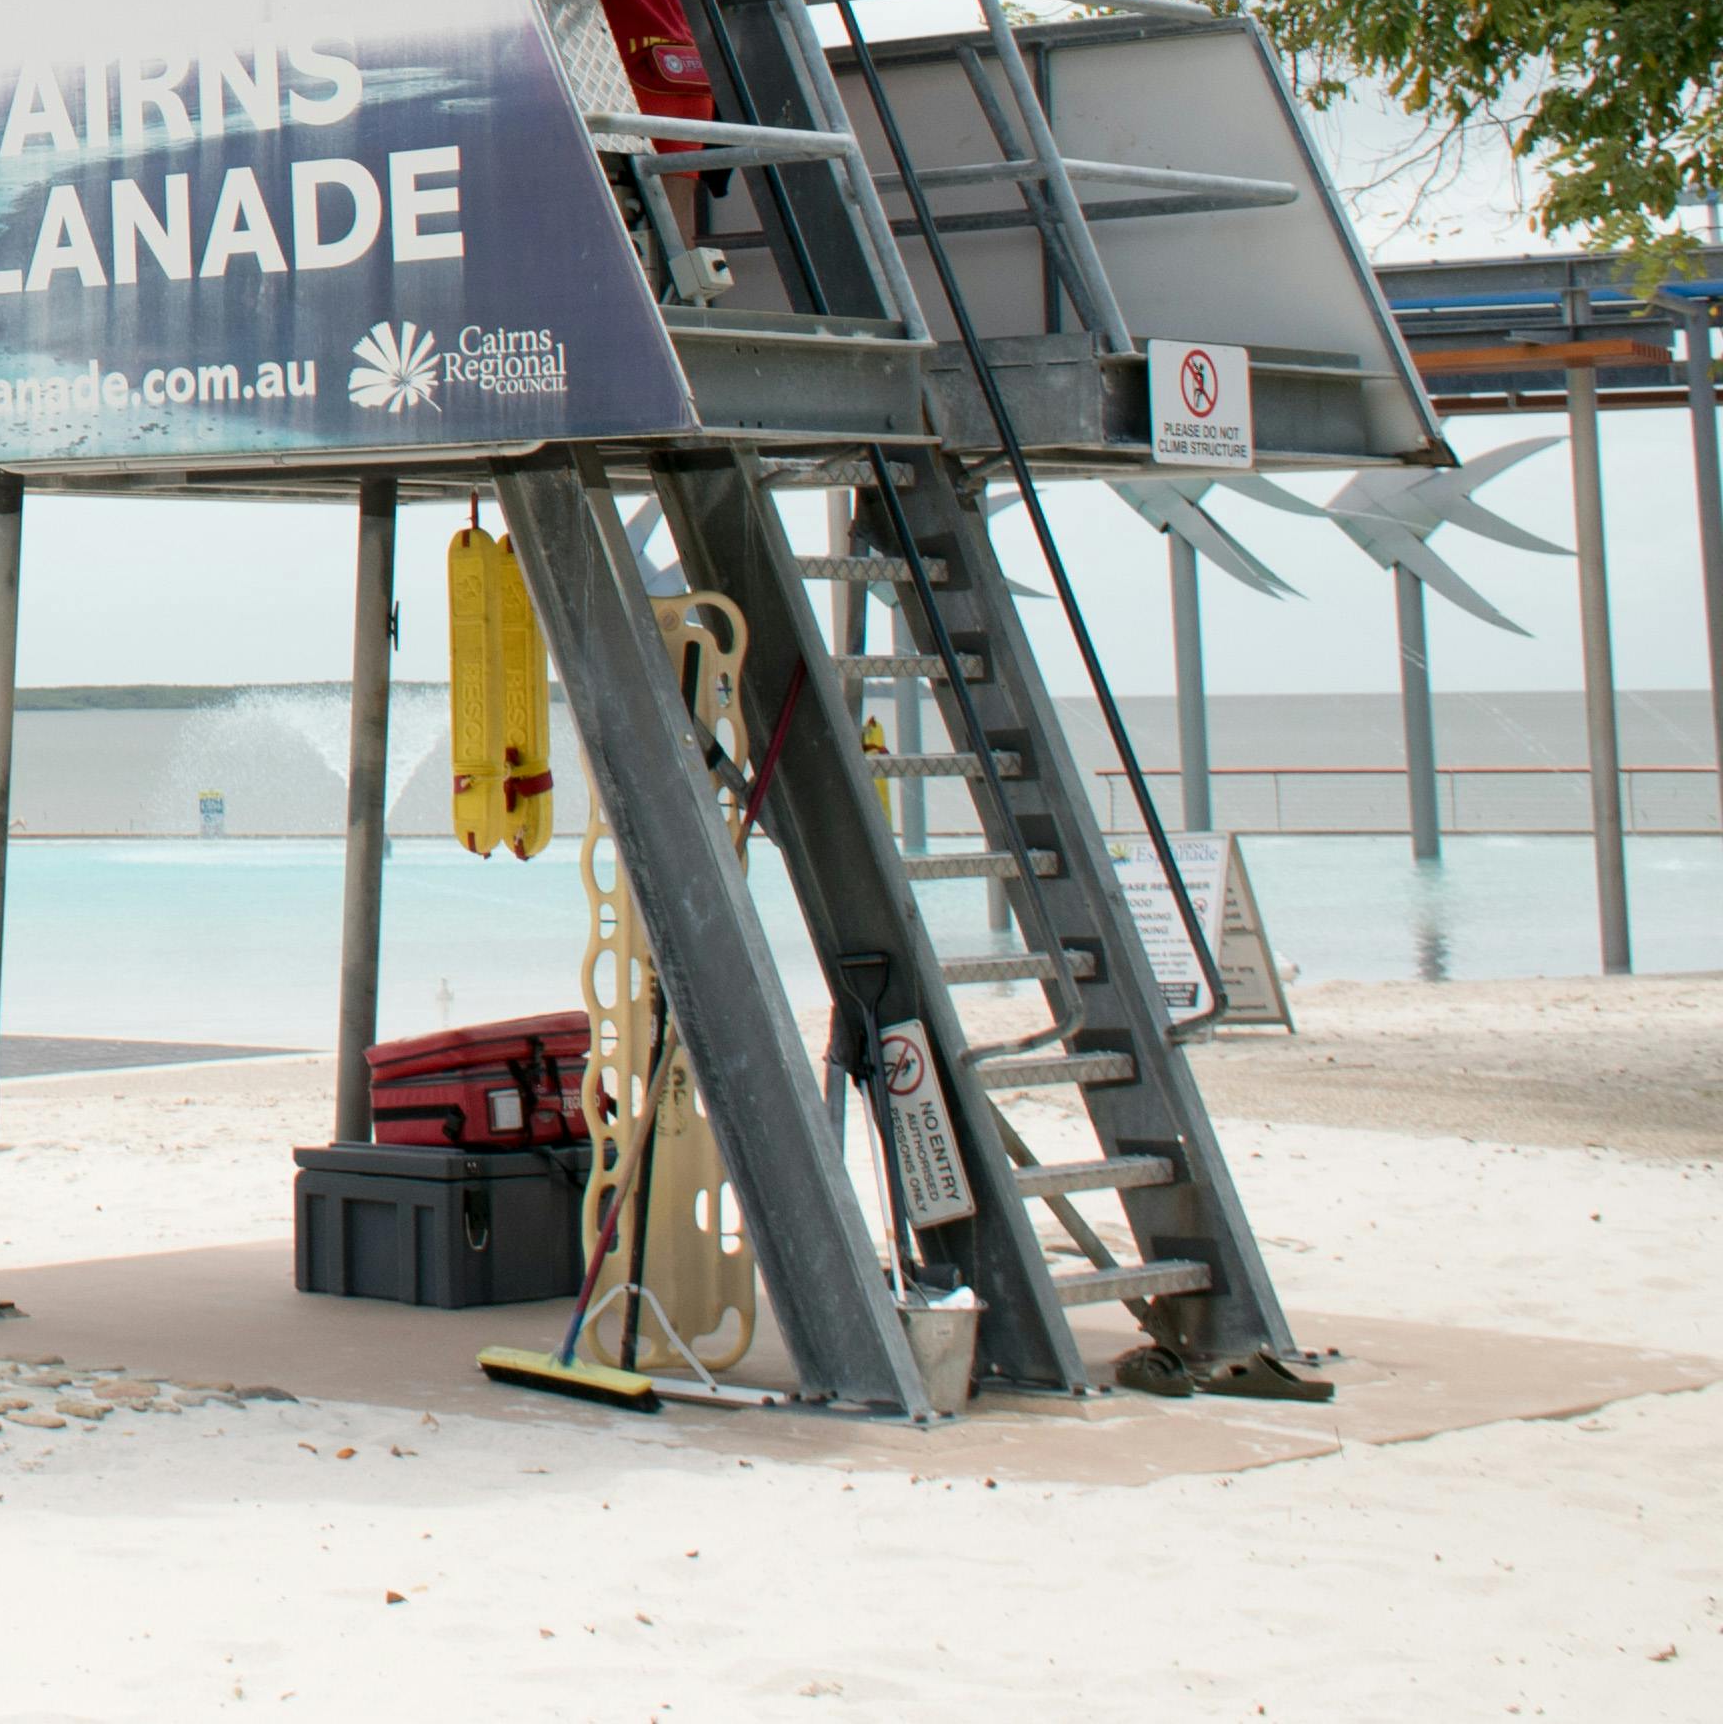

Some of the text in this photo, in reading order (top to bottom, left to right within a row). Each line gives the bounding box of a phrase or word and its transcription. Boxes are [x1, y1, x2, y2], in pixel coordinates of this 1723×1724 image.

[443, 343, 567, 390] Regional
[459, 326, 553, 356] Cairns
[496, 376, 568, 394] COUNCIL
[1158, 439, 1248, 457] CLIMB STRUCTURE
[1164, 422, 1239, 440] PLEASE DO NOT
[462, 660, 483, 758] RESCU
[506, 668, 526, 746] RESC
[891, 1107, 927, 1213] PERSONS ONLY
[906, 1112, 939, 1202] AUTHORISED
[919, 1099, 960, 1200] NO ENTRY
